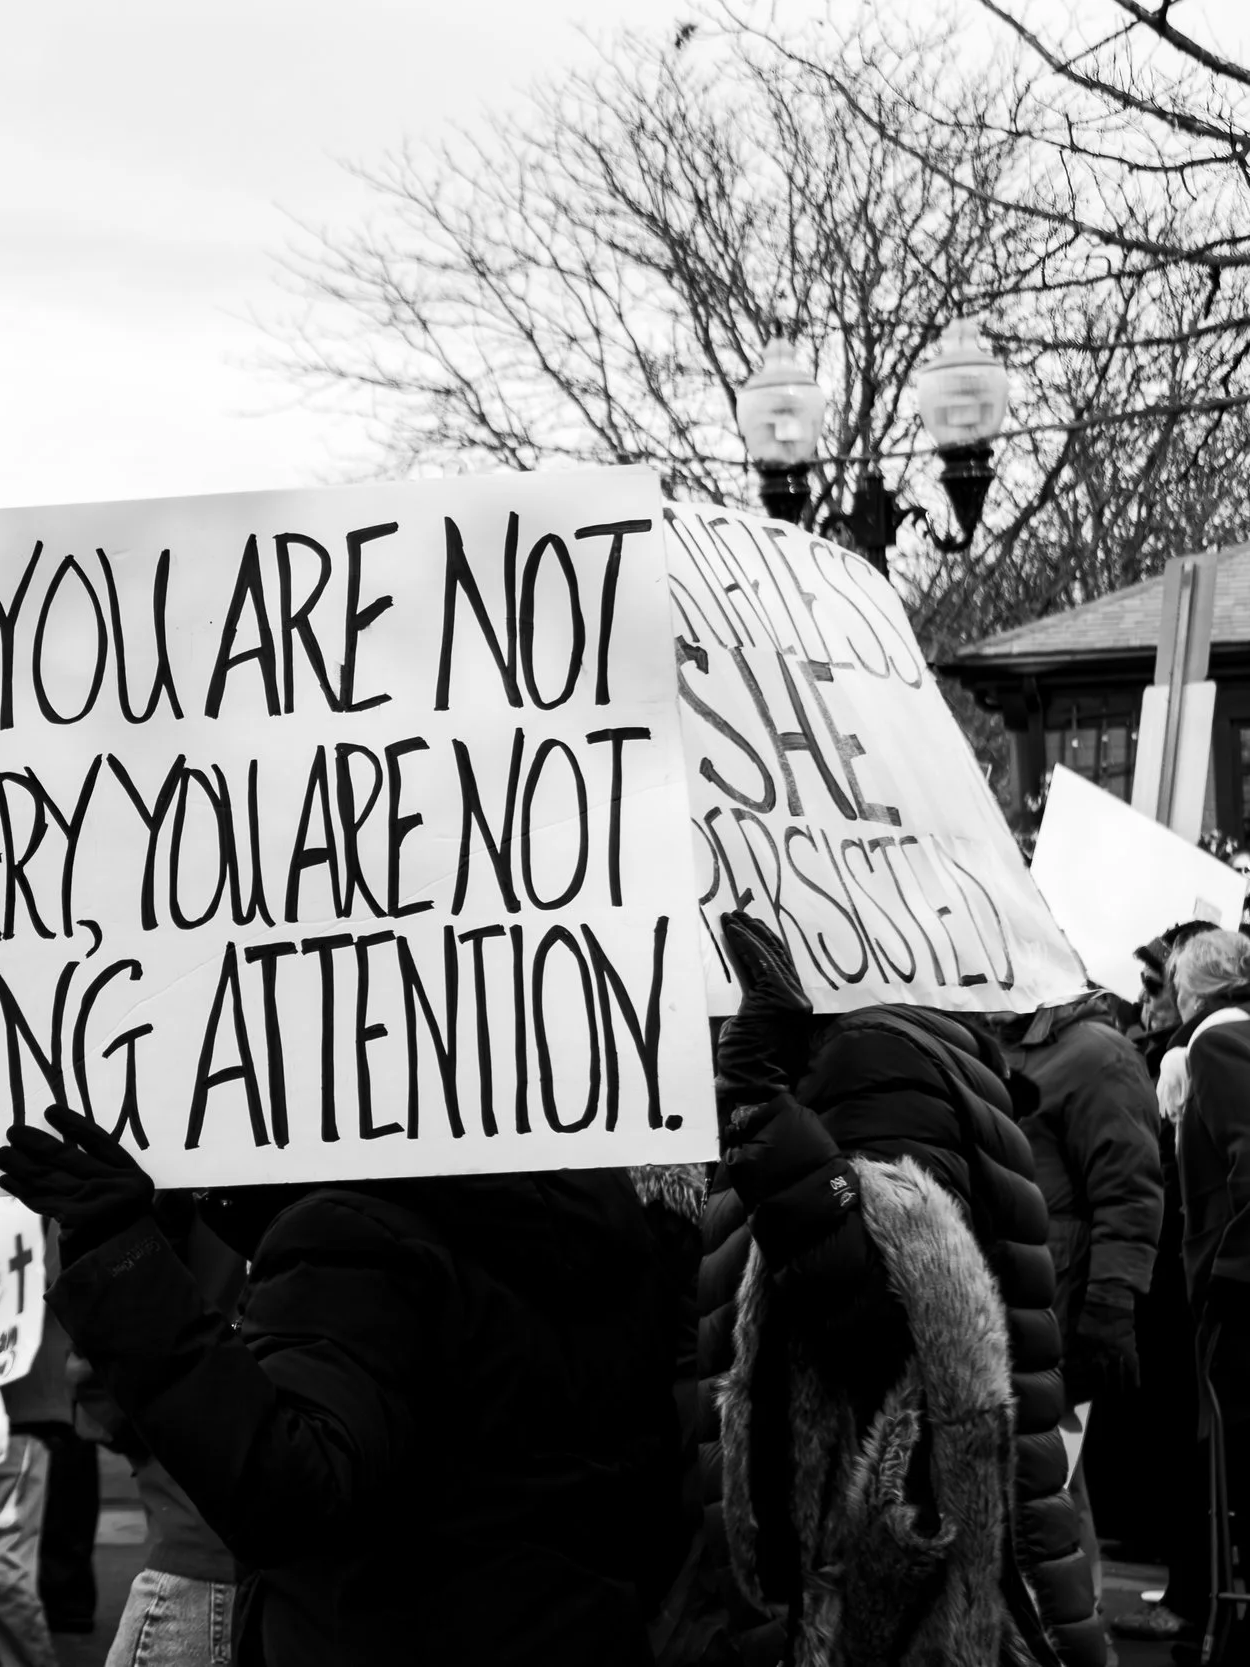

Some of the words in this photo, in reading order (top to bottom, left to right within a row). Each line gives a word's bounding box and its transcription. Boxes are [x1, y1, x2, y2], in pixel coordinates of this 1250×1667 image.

[204, 521, 399, 719] ARE
[434, 511, 652, 711] NOT
[107, 753, 277, 931] YOU
[284, 736, 435, 923] ARE
[451, 727, 652, 917] NOT
[676, 633, 903, 827] SHE
[184, 916, 684, 1150] ATTENTION.
